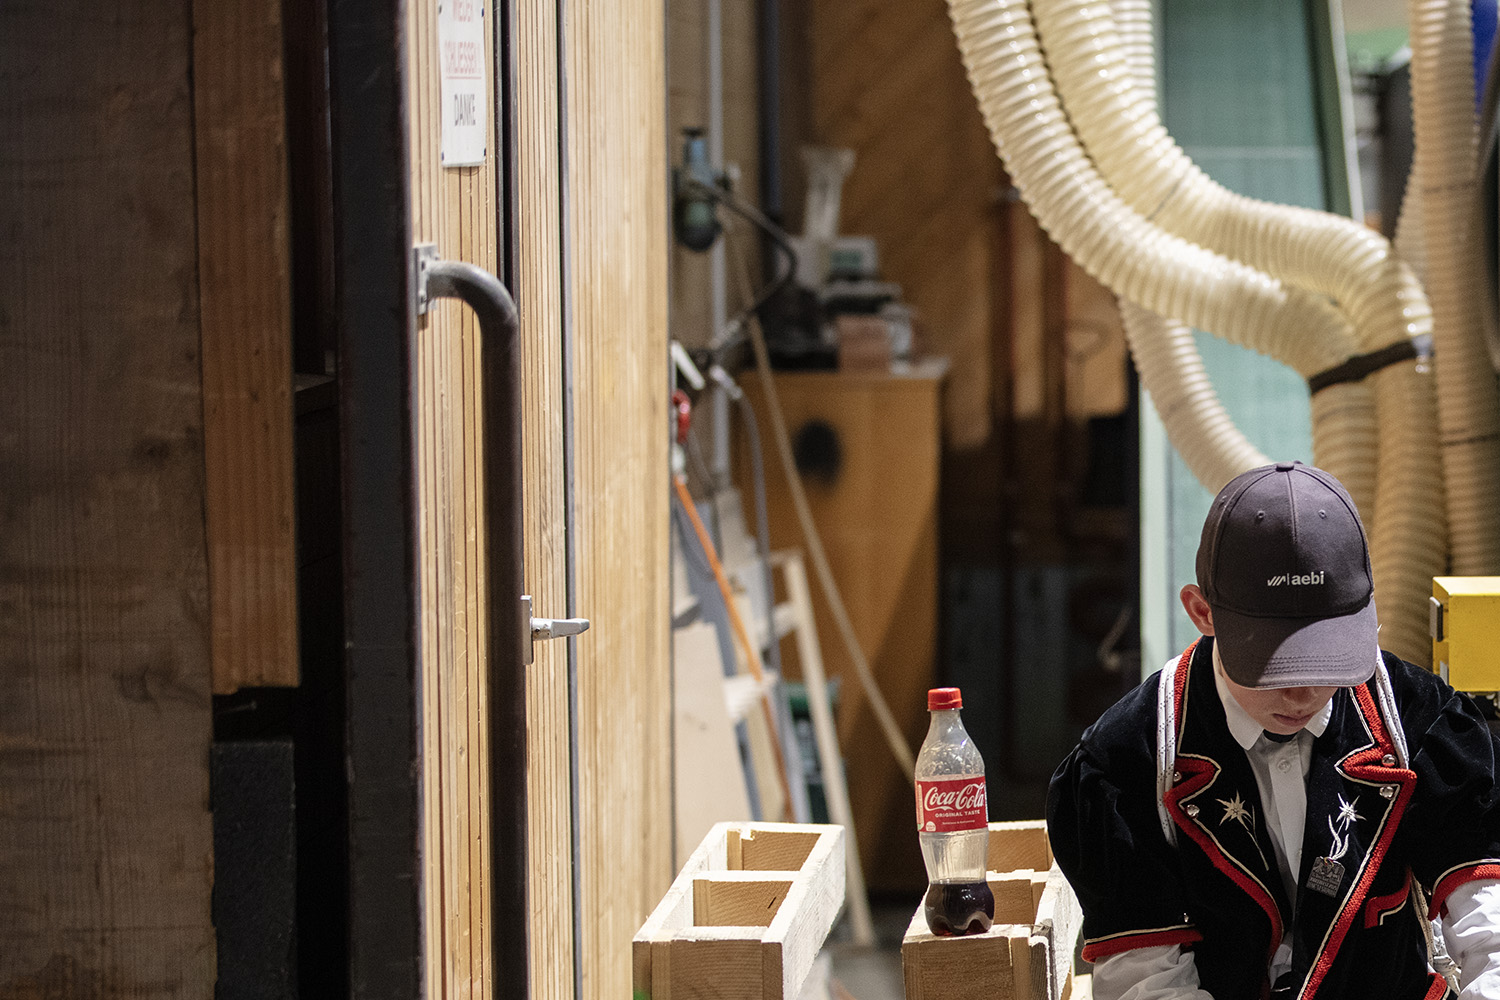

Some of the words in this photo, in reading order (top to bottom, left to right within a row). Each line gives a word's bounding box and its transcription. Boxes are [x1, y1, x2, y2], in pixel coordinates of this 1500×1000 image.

[454, 93, 476, 126] DANKE
[1291, 571, 1325, 585] aebi
[924, 782, 985, 811] Coca-Cola
